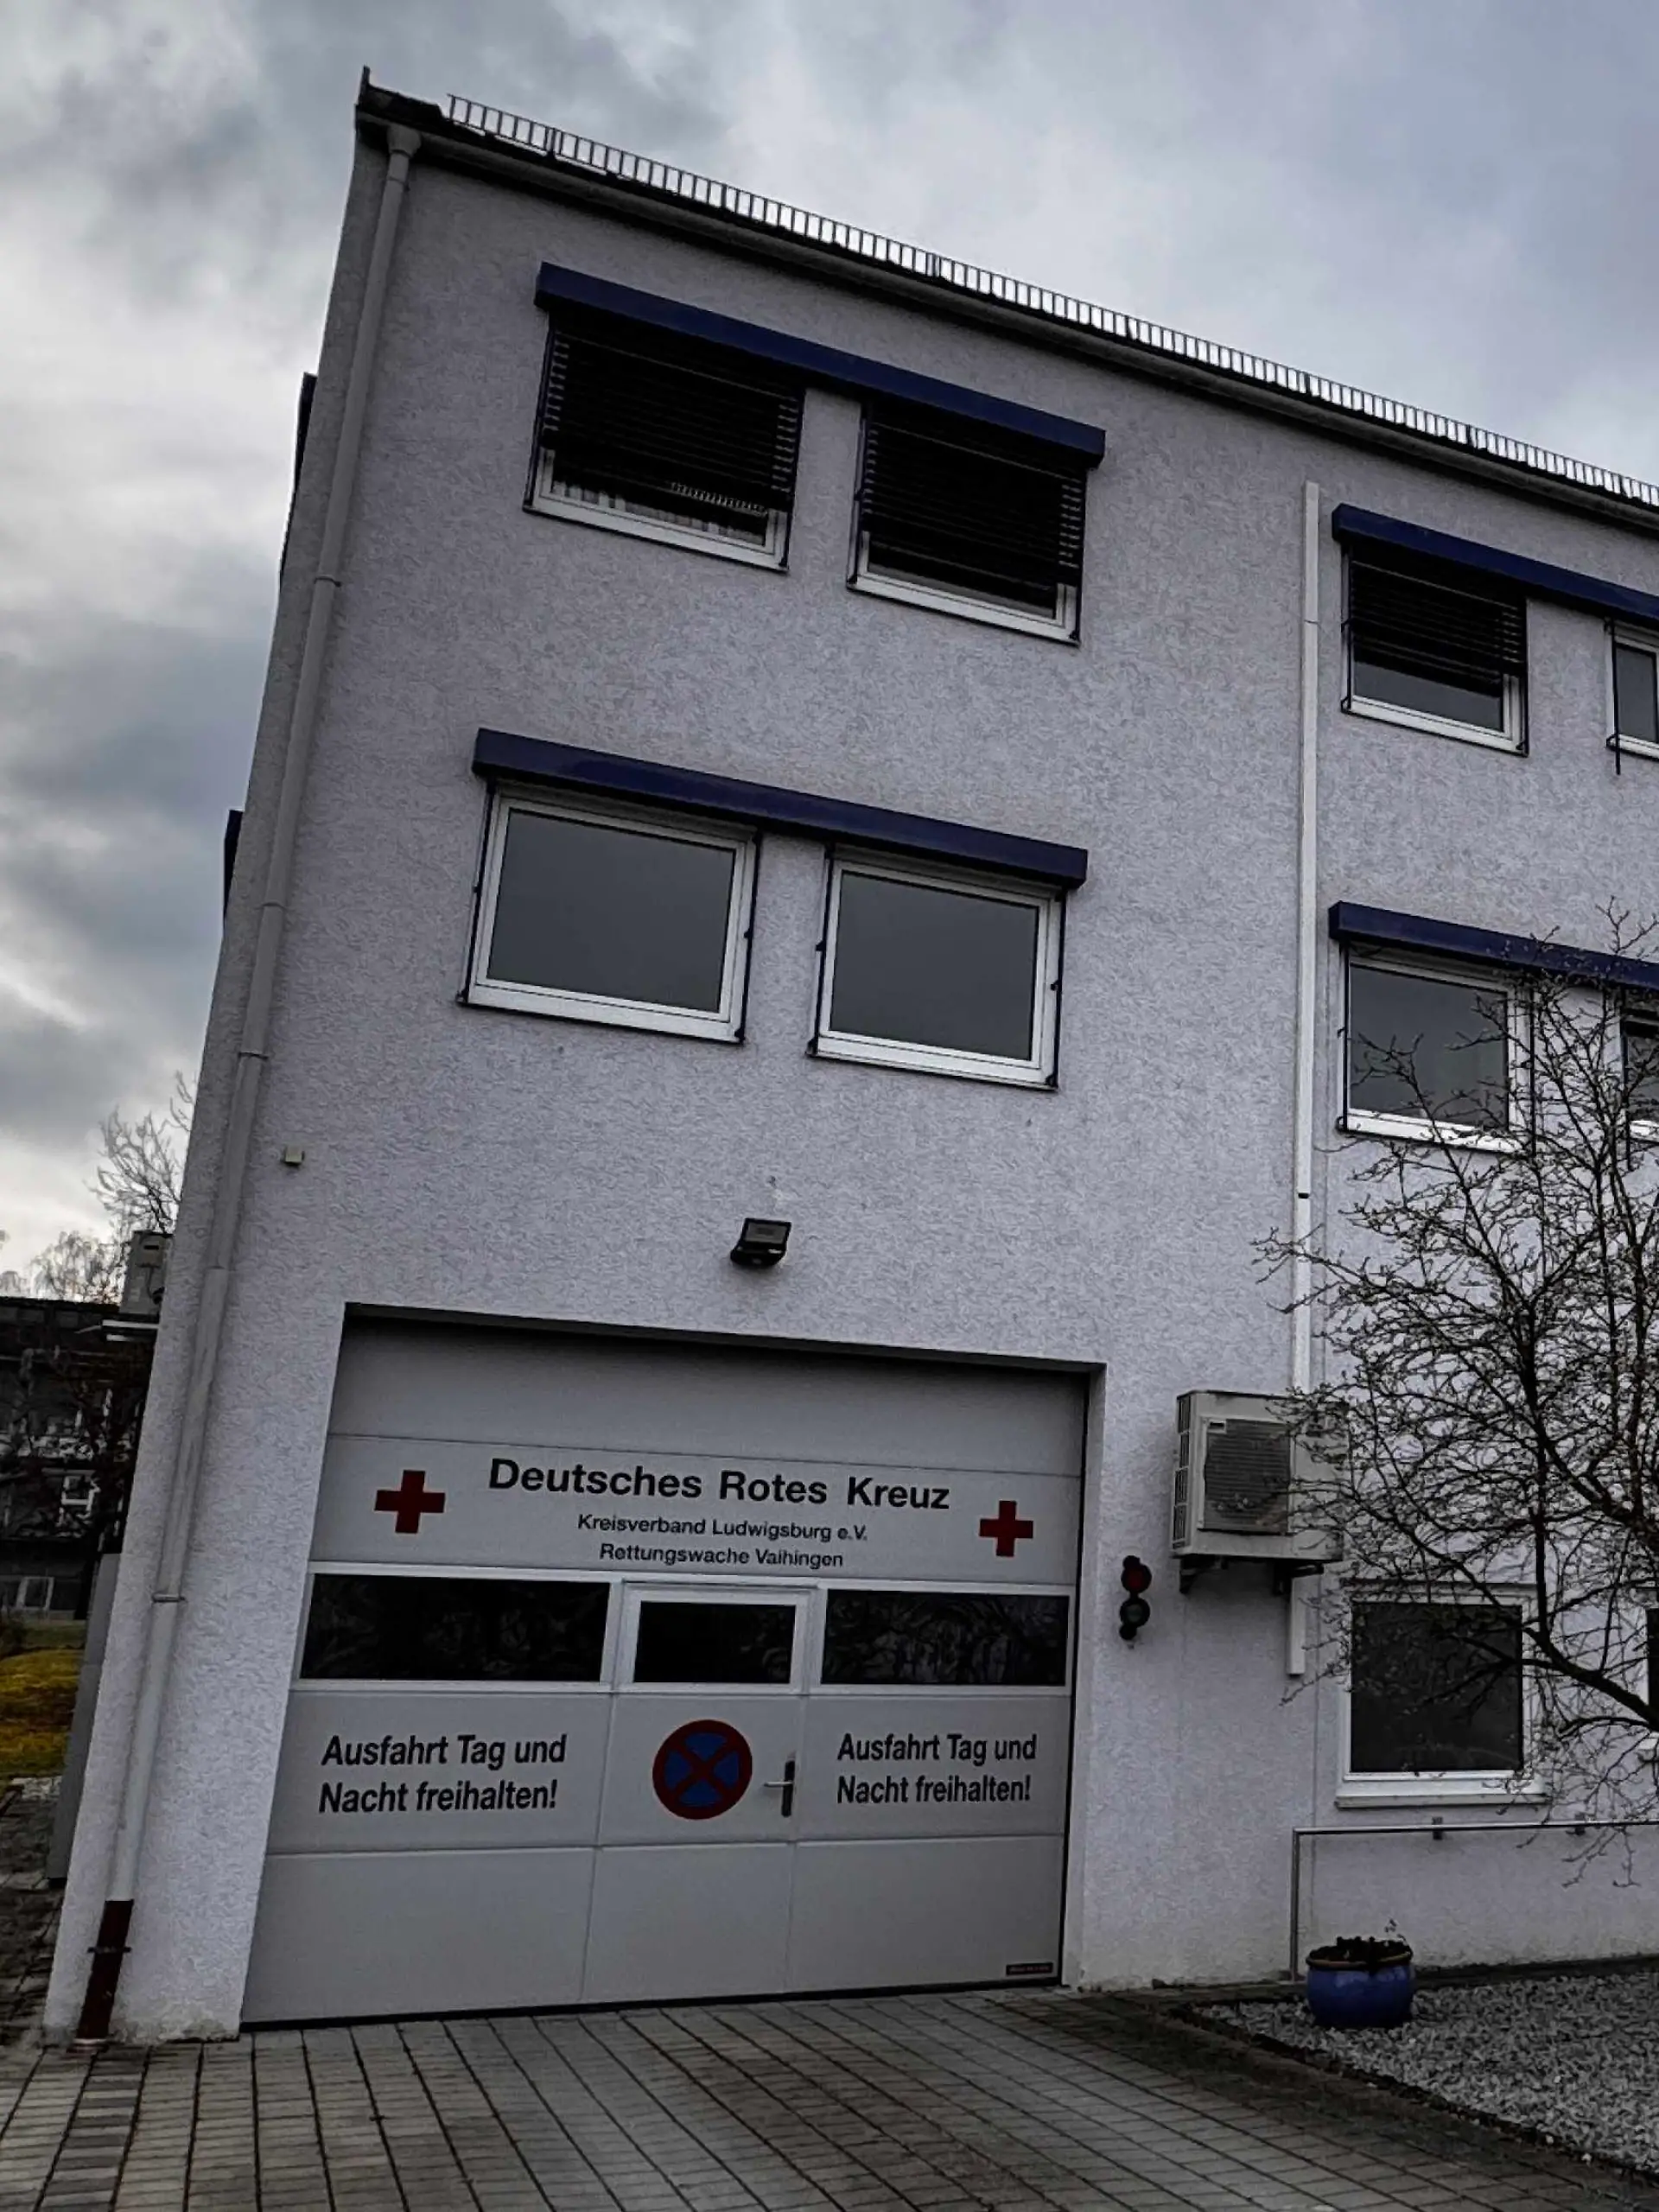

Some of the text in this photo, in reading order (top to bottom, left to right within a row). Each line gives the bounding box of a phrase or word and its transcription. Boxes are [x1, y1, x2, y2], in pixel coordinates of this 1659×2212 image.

[489, 1457, 950, 1510] Deutsches Rotes Kreuz
[577, 1514, 868, 1543] Kreisverband Ludwigsburg e.V.
[599, 1542, 843, 1570] Rettungswache Vaihingen
[321, 1733, 568, 1771] Ausfahrt Tag und
[836, 1732, 1038, 1767] Ausfahrt Tag und
[318, 1778, 558, 1814] Nacht freihalten!
[836, 1774, 1031, 1804] Nacht freihalten!
